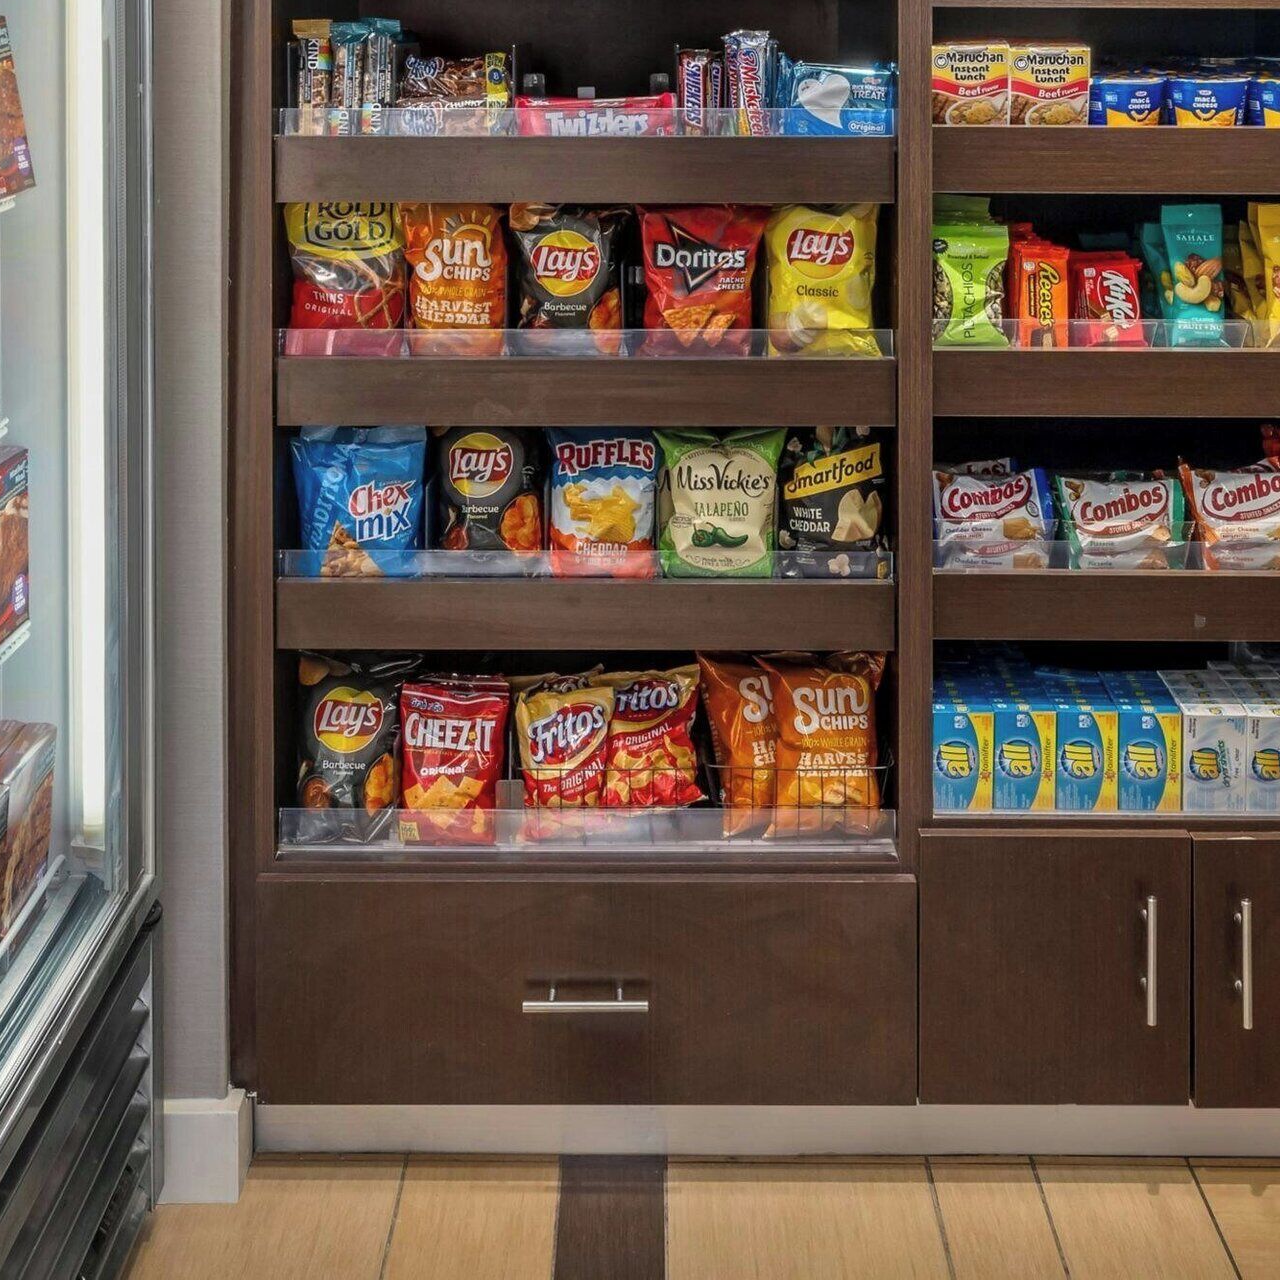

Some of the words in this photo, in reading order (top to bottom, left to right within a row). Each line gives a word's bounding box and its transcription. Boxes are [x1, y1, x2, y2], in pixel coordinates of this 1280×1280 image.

[307, 38, 320, 70] KIND
[946, 52, 1004, 64] Maruchan
[1026, 54, 1085, 66] Maruchan
[950, 64, 990, 73] Instant
[954, 72, 986, 81] Lunch
[1030, 66, 1070, 76] Instant
[1034, 74, 1066, 84] Lunch
[683, 60, 701, 127] SNICKERS
[852, 90, 888, 101] TREATS
[957, 85, 982, 97] Beef
[1038, 87, 1062, 99] Beef
[369, 102, 382, 135] KIND
[848, 121, 885, 134] Original
[314, 220, 386, 241] GOLD
[1175, 233, 1216, 243] SAHALE
[655, 243, 748, 269] Doritos
[789, 229, 852, 266] Lay's
[416, 236, 493, 282] Sun
[535, 245, 598, 284] Lay's
[442, 265, 492, 282] CHIPS
[717, 283, 745, 291] CHEESE
[796, 284, 839, 299] Classic
[1037, 261, 1061, 328] Reese's
[312, 290, 345, 305] THINS
[414, 295, 493, 312] HARVEST
[304, 302, 353, 317] ORIGINAL
[544, 301, 588, 312] Barbecue
[414, 309, 492, 325] CHEDDAR
[556, 437, 655, 475] RUFFLES
[451, 447, 510, 483] Lay's
[676, 465, 716, 492] Miss
[709, 460, 773, 498] Vickie's
[786, 457, 877, 493] Smartfood
[348, 480, 417, 518] Chex
[947, 474, 1025, 513] Combos
[1080, 484, 1164, 522] Combos
[793, 506, 822, 520] WHITE
[790, 519, 831, 534] CHEDDAR
[318, 700, 380, 738] Lay's
[792, 687, 869, 736] Sun
[819, 715, 869, 730] CHIPS
[527, 703, 605, 764] Fritos
[625, 722, 673, 746] ORIGINAL
[322, 759, 366, 771] Barbecue
[560, 761, 605, 791] ORIGINAL
